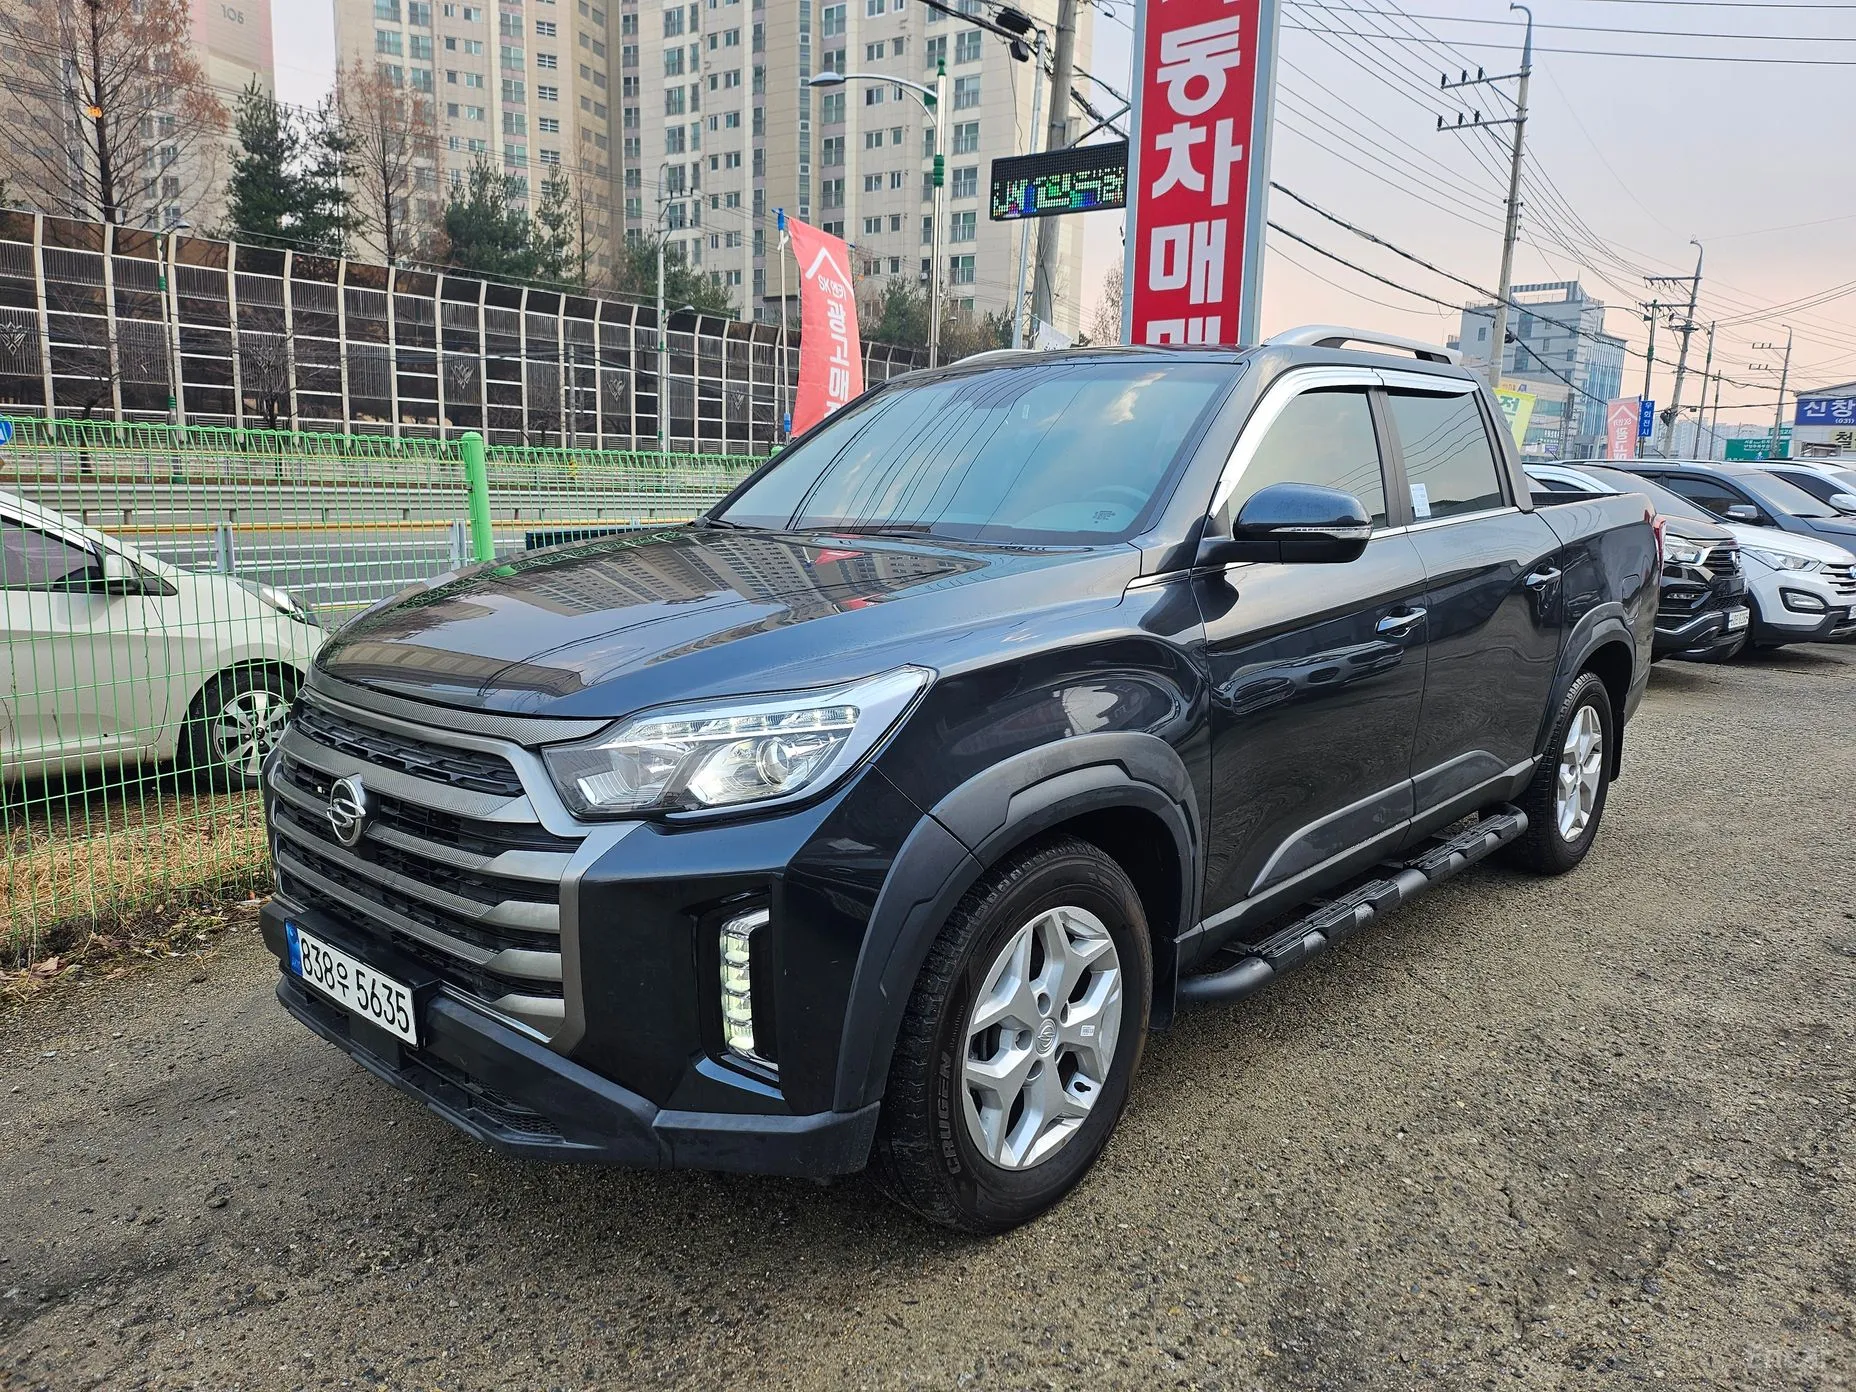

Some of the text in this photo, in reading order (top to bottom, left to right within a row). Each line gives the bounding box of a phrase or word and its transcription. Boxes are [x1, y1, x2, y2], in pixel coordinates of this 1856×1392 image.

[1145, 0, 1243, 344] 동차매
[1803, 400, 1856, 418] 신창
[1834, 431, 1856, 449] 철
[301, 937, 410, 1034] 838우 5635
[938, 1050, 961, 1175] CRUGEN
